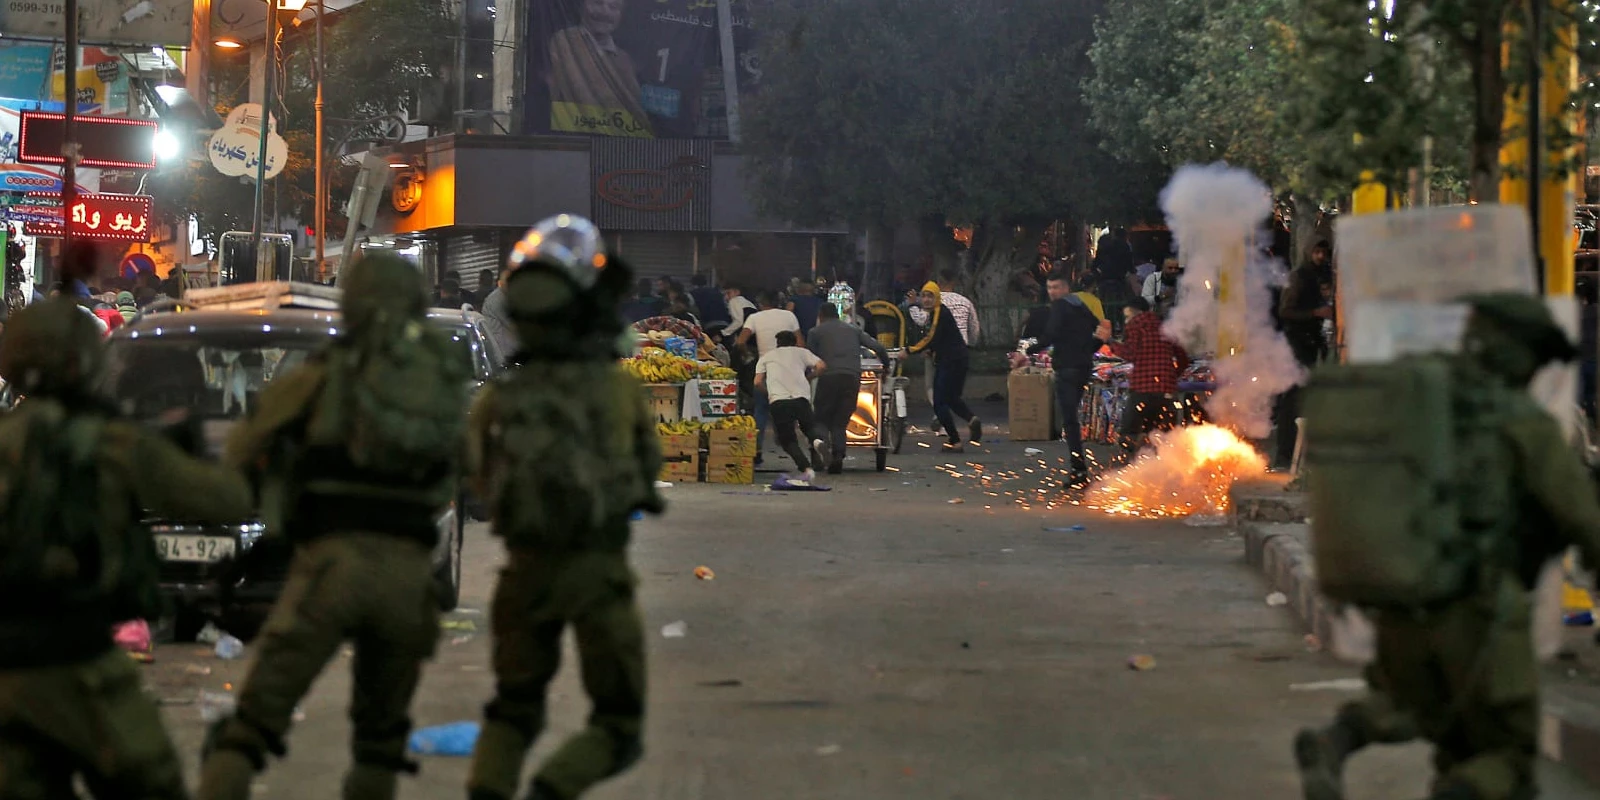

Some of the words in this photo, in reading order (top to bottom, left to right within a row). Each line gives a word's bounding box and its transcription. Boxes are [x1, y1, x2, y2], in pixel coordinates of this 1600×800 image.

[9, 2, 65, 14] 0599-318
[612, 113, 625, 128] 6
[212, 137, 247, 161] كهرباء
[6, 176, 55, 187] ooredoo
